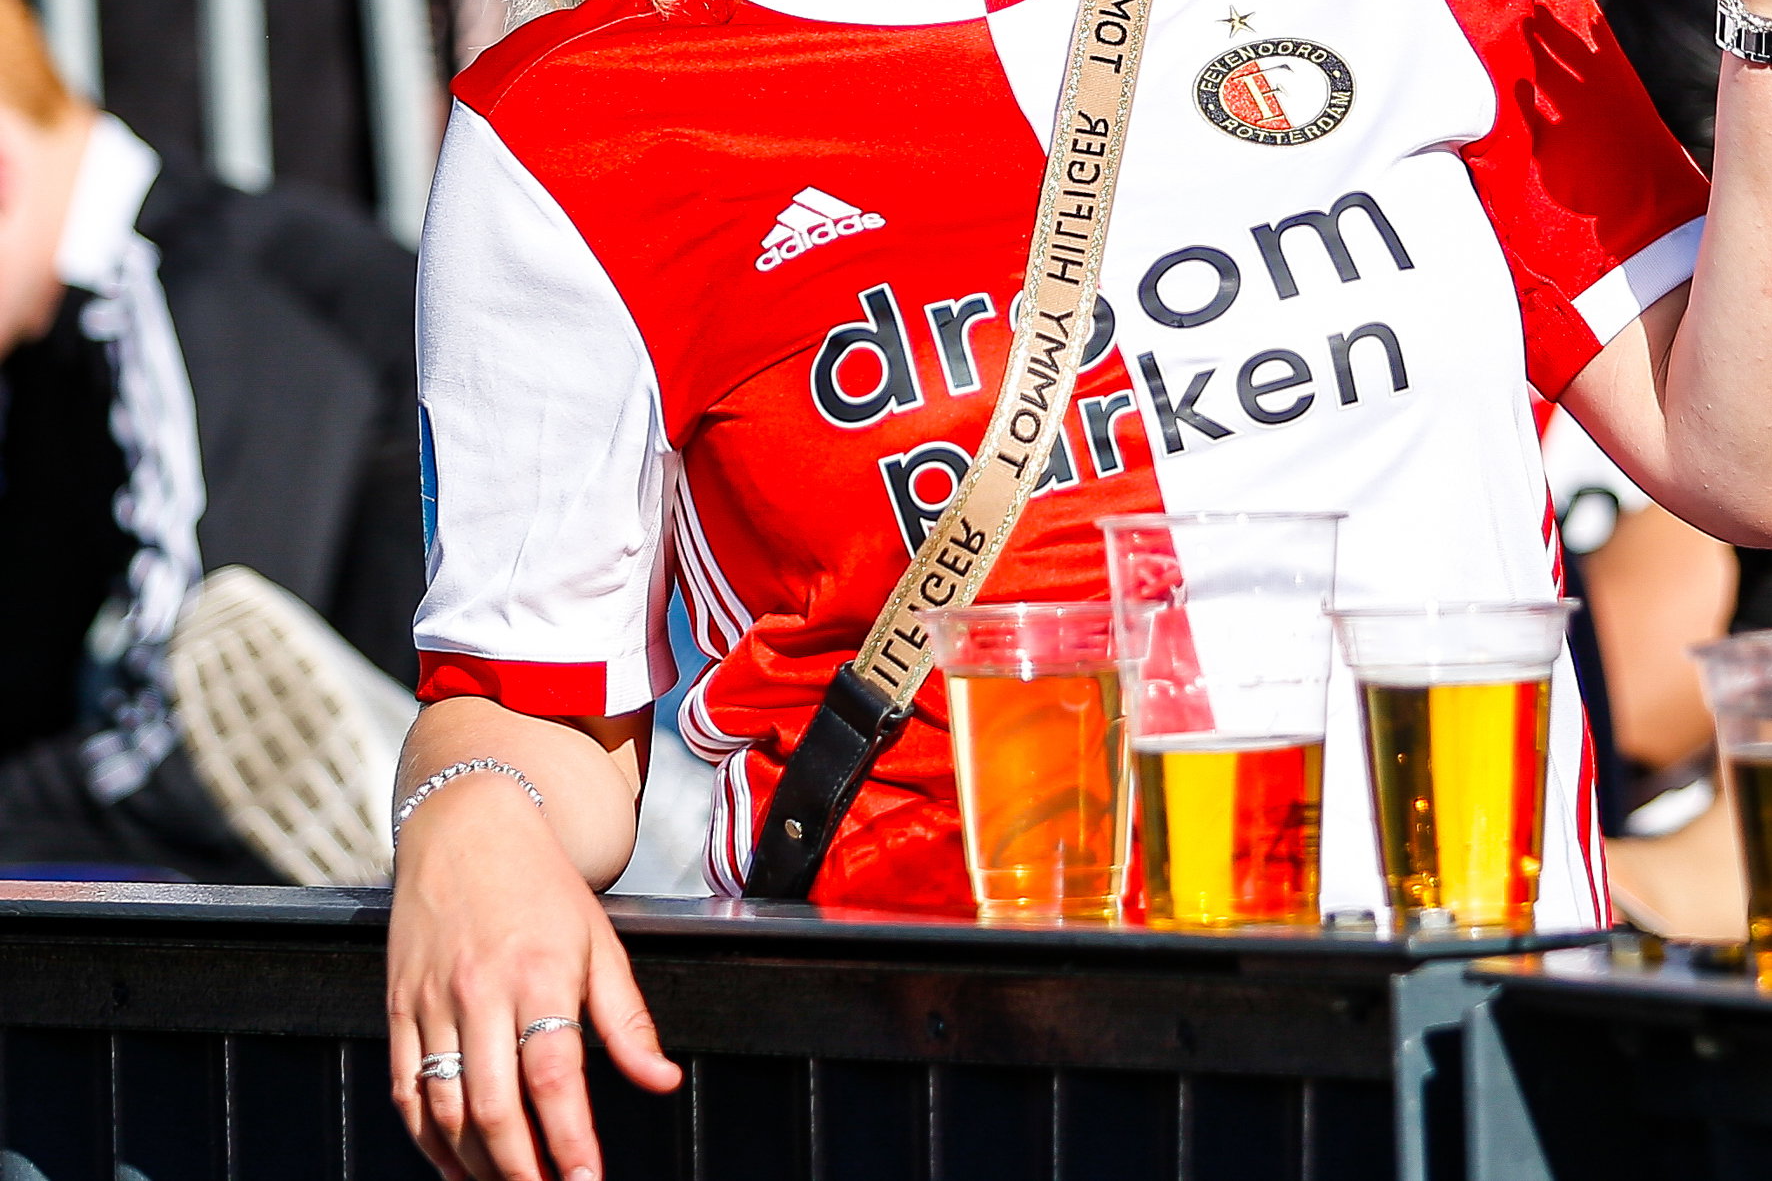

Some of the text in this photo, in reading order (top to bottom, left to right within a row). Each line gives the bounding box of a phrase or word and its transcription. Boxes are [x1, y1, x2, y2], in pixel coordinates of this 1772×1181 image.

[1200, 41, 1328, 93] FEYENOORD
[1218, 90, 1352, 145] ROTTERDAM
[754, 211, 887, 272] adidas
